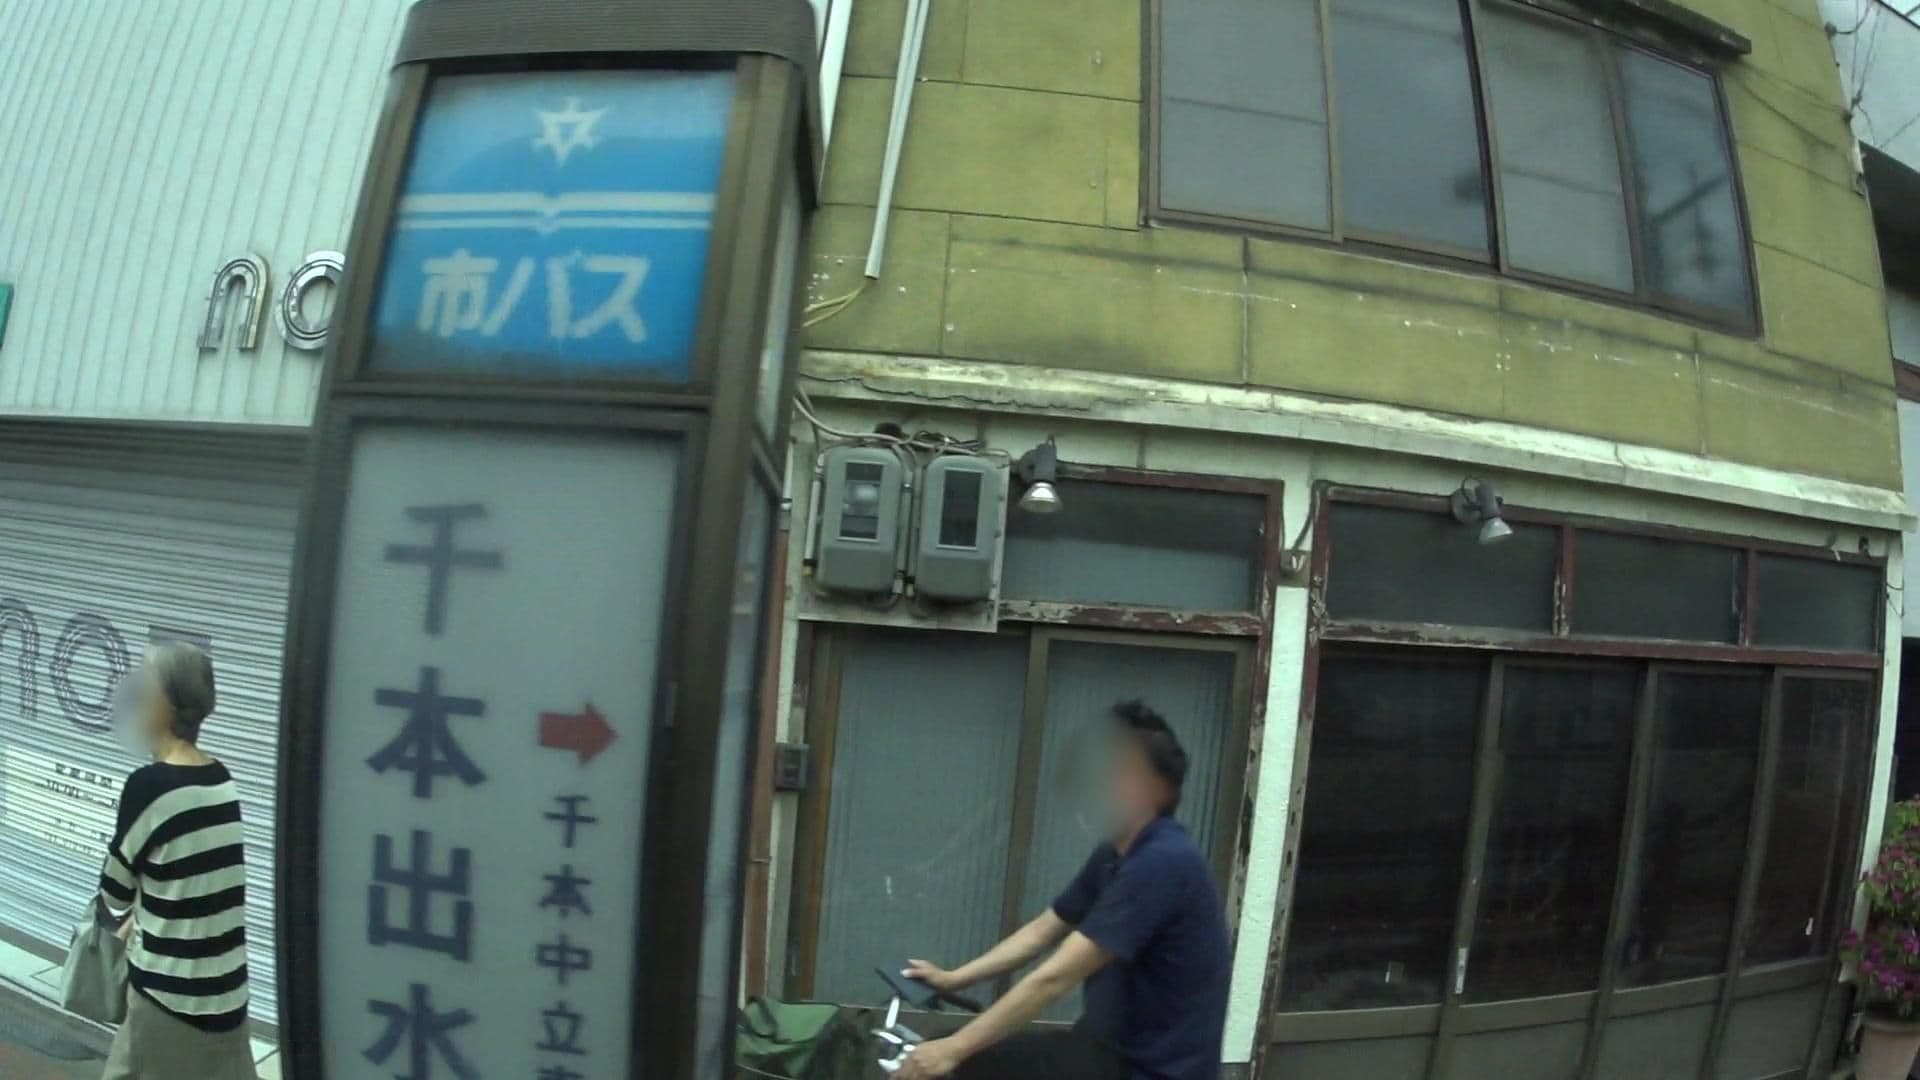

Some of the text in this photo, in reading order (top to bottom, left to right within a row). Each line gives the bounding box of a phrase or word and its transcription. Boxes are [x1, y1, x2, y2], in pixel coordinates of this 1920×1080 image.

[416, 248, 652, 344] 市バス
[362, 503, 505, 1080] 千本出水
